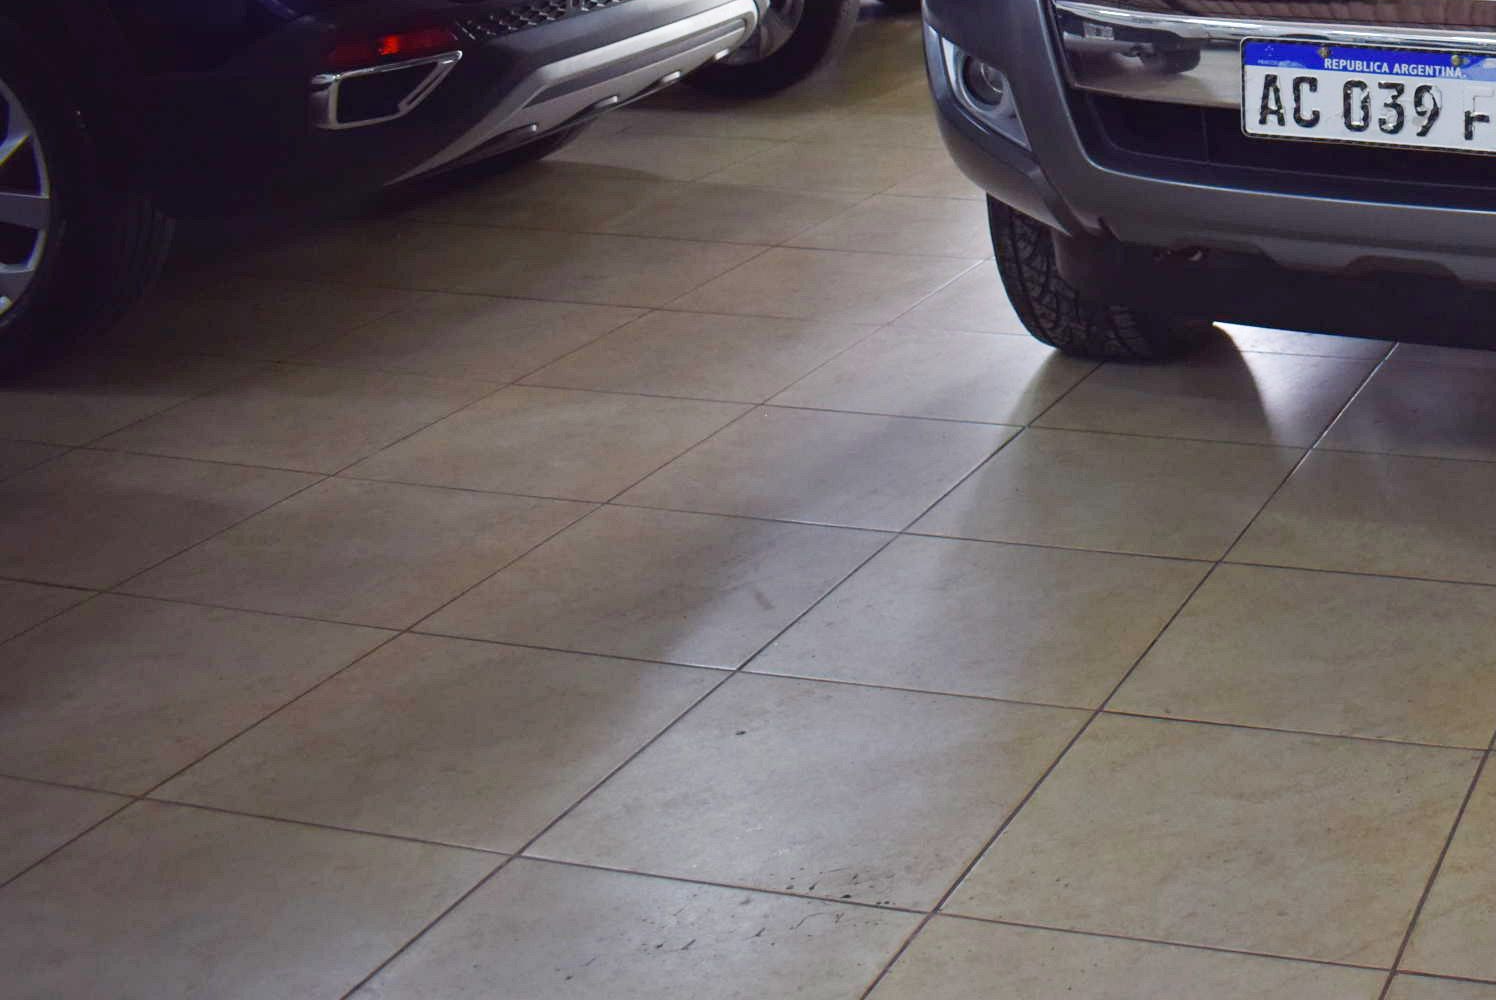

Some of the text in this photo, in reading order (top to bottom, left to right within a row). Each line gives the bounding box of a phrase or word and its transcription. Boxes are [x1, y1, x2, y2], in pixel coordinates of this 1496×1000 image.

[1324, 57, 1390, 74] REPUBLICA
[1258, 73, 1321, 128] AC
[1343, 79, 1442, 137] 039
